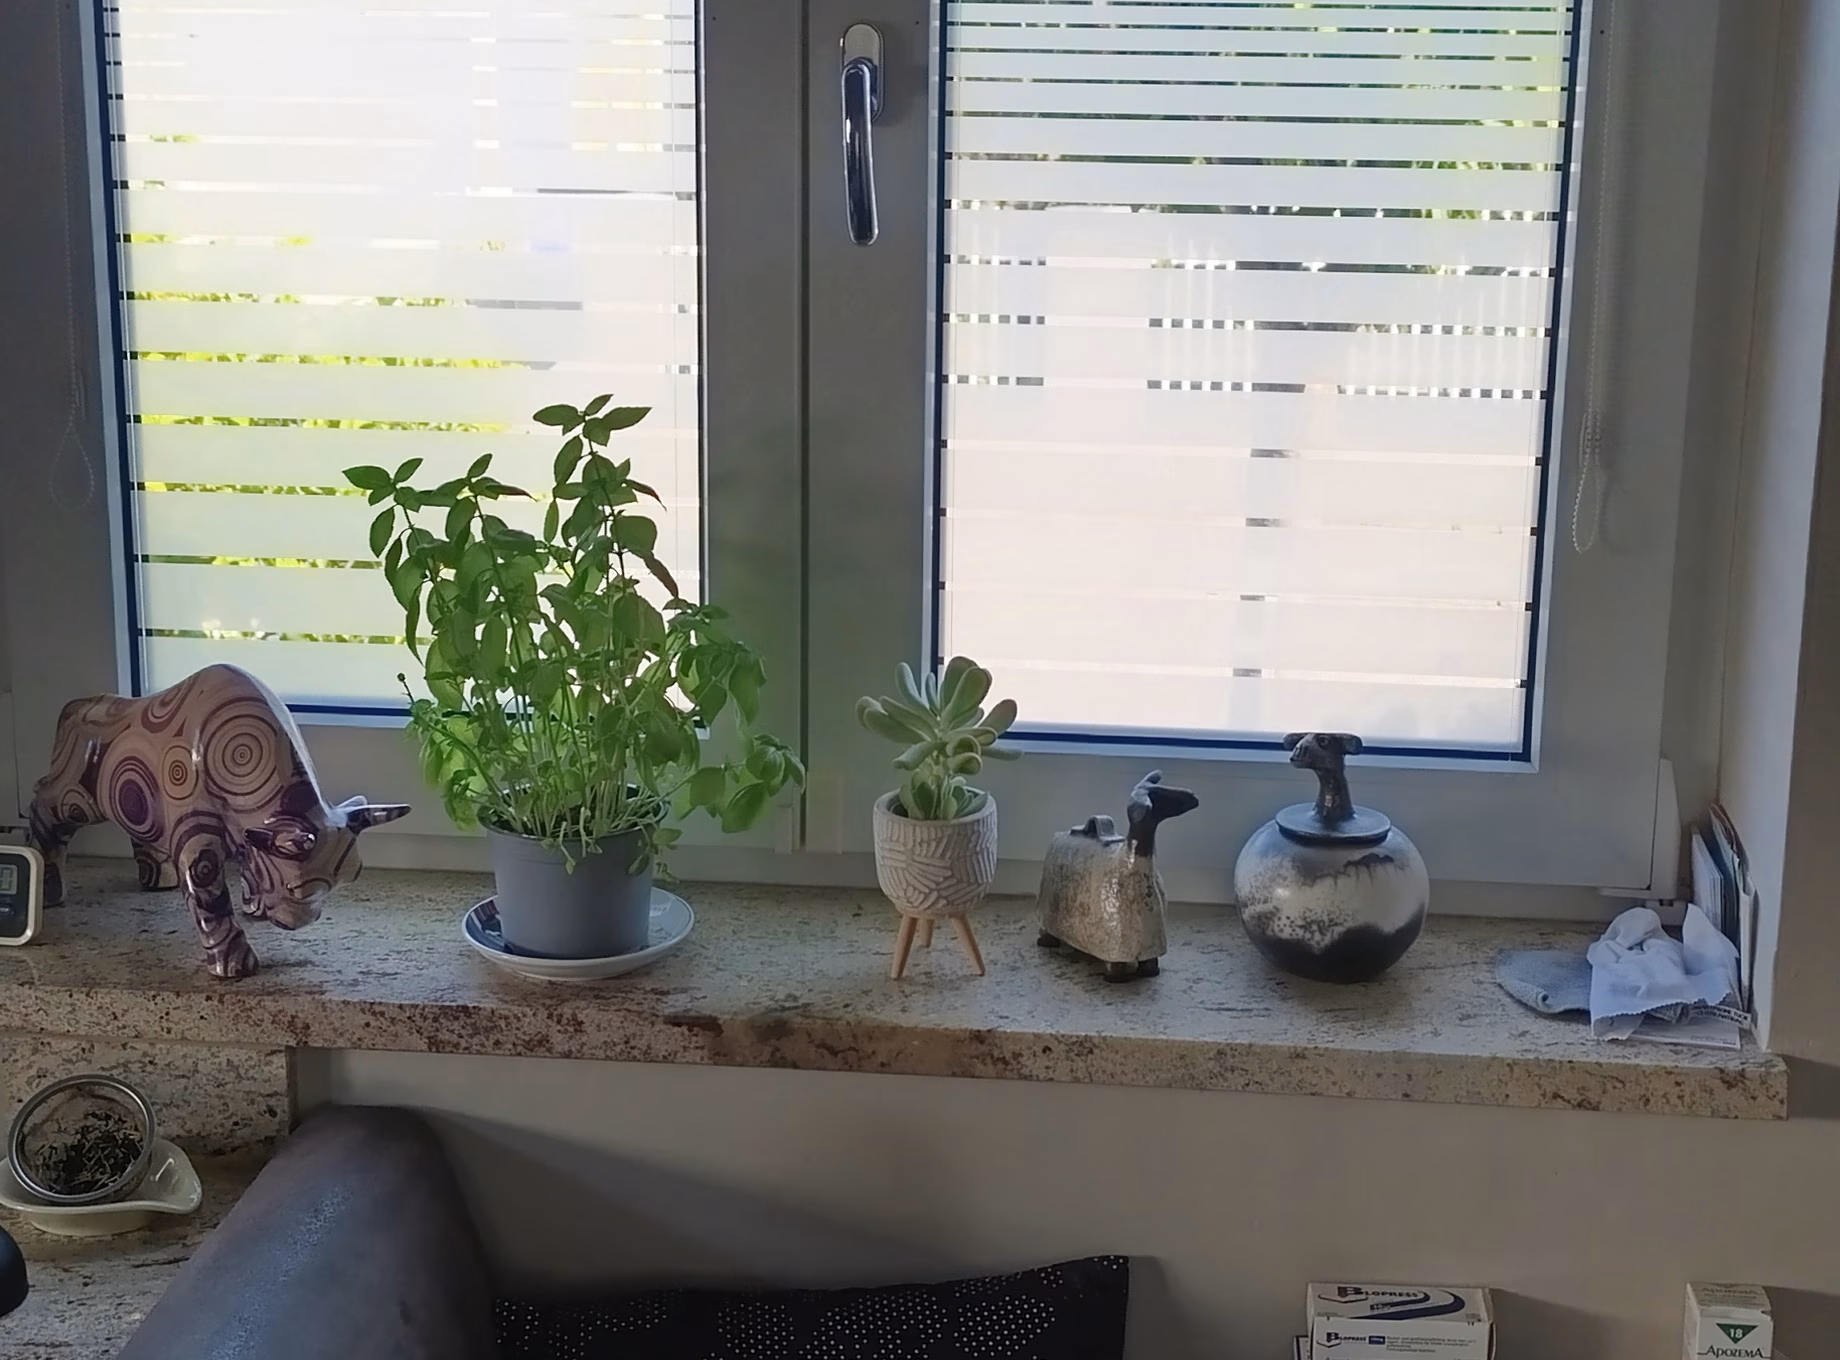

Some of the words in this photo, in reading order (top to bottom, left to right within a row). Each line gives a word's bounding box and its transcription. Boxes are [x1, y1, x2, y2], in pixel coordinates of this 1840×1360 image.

[1337, 1286, 1418, 1299] BLOPRESS
[1729, 1328, 1743, 1338] 18
[1706, 1344, 1764, 1359] APOZEMA
